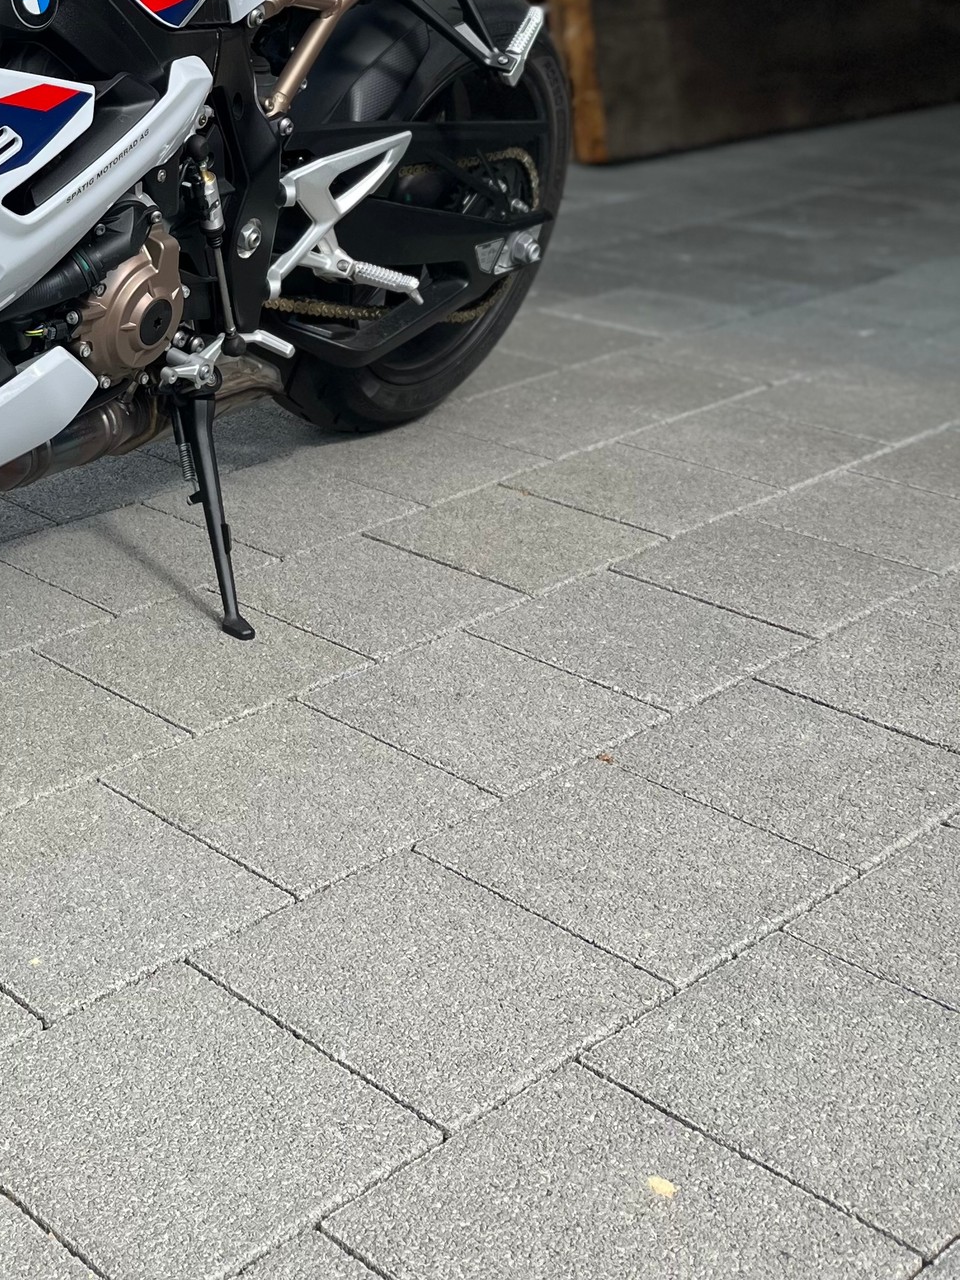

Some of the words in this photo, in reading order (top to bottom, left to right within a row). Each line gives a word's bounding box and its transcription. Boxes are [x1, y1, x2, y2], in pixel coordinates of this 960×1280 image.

[66, 177, 95, 204] SPÄTIG
[96, 139, 139, 180] MOTORRAD
[139, 128, 150, 141] AG
